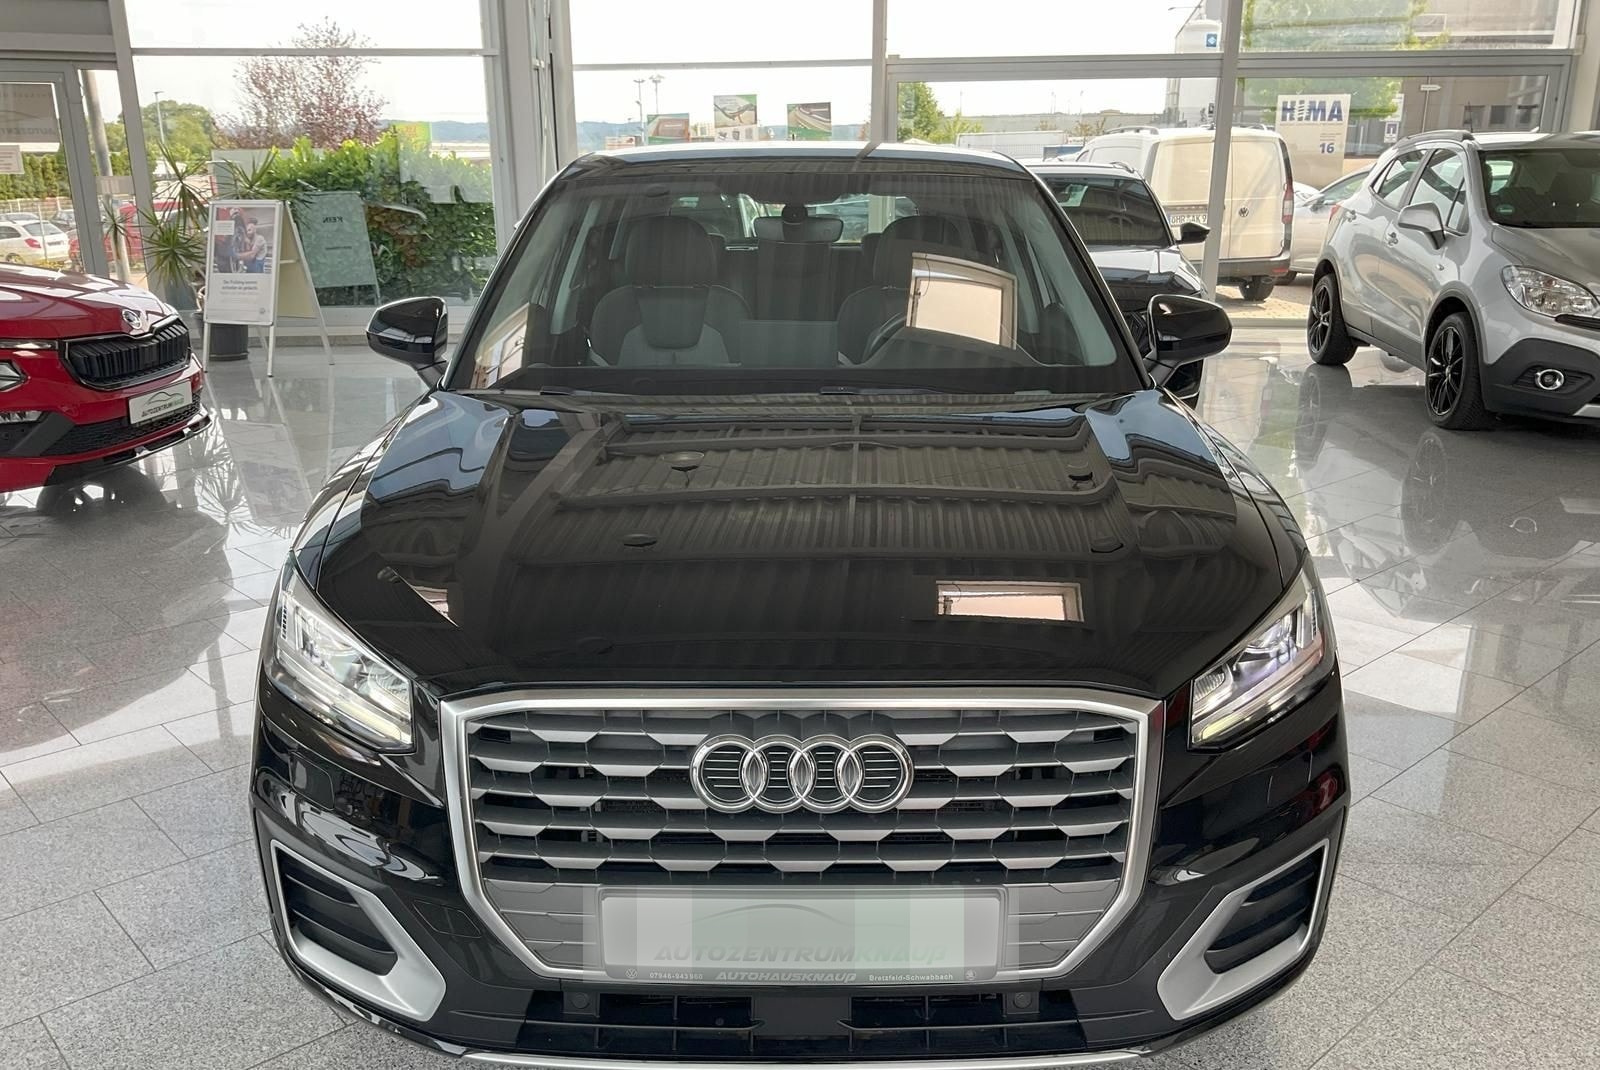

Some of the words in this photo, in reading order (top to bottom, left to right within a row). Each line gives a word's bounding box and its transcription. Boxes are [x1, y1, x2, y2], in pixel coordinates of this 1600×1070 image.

[1280, 99, 1343, 122] HIMA
[1319, 142, 1335, 154] 16
[868, 972, 954, 982] Bretzfeld-Schwabbach
